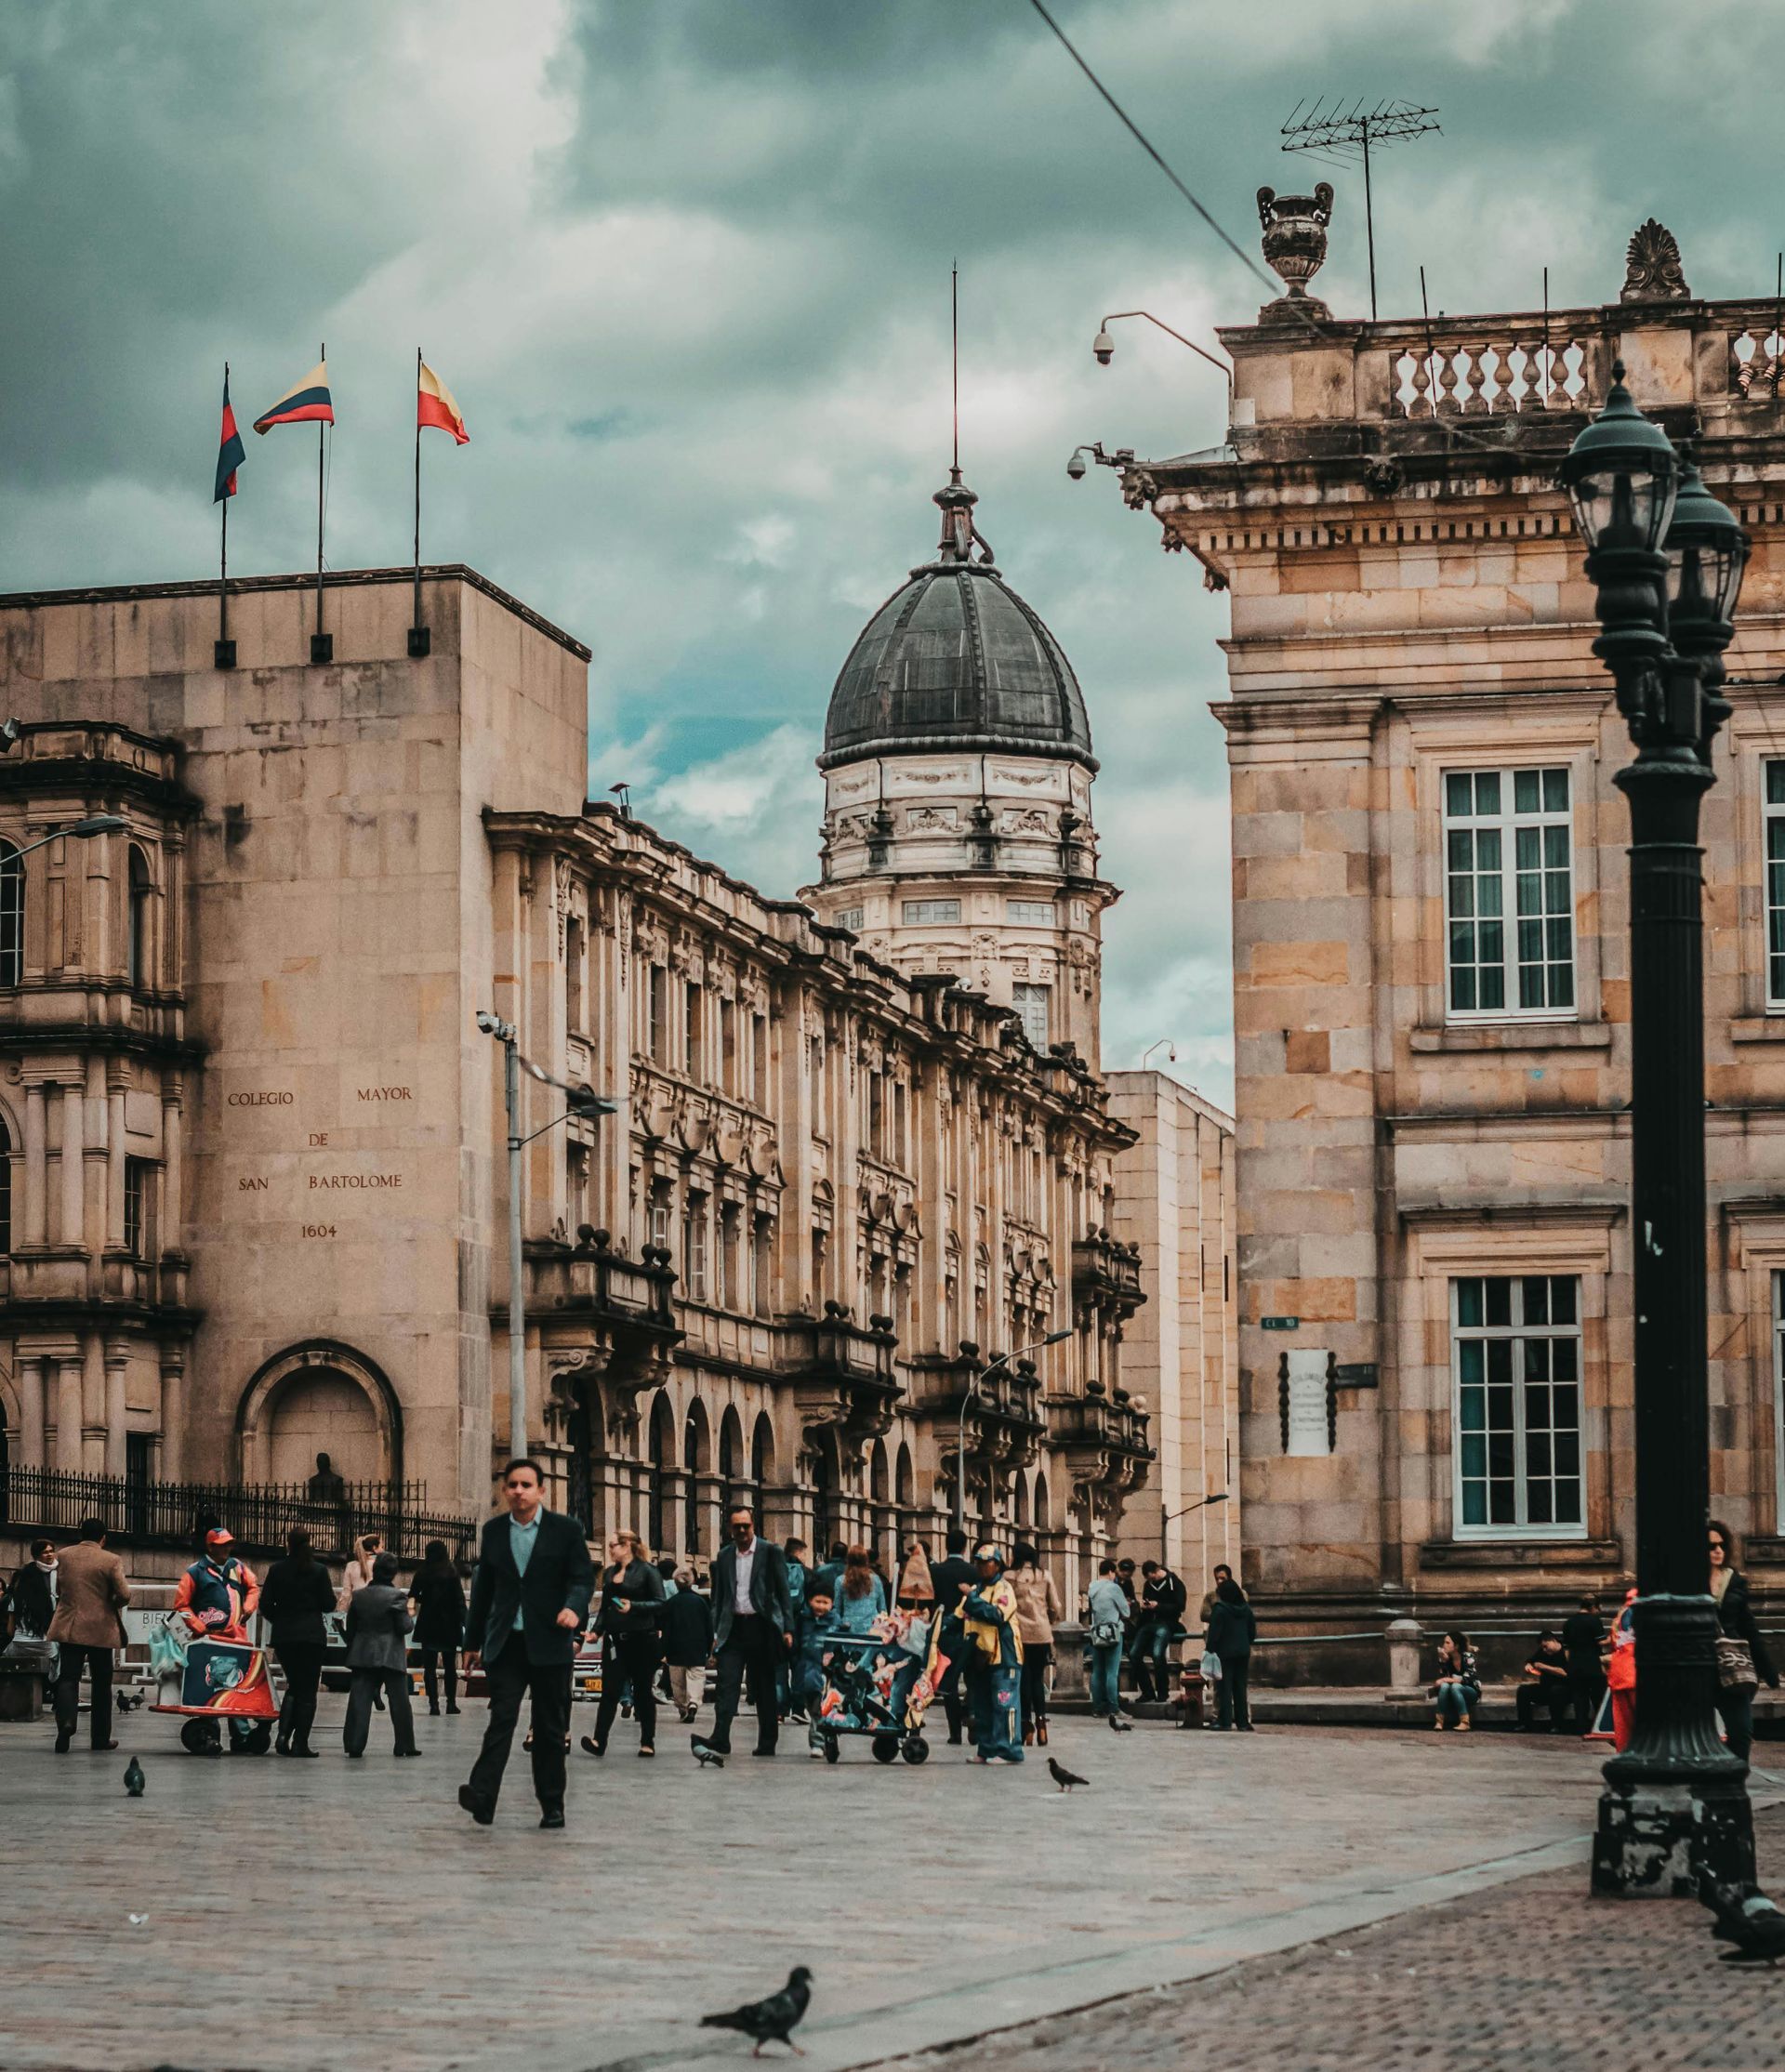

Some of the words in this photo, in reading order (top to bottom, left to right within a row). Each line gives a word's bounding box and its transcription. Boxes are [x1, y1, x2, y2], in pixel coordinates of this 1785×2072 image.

[228, 1091, 294, 1106] COLEGIO
[357, 1087, 412, 1102] MAYOR
[309, 1133, 328, 1146] DE
[238, 1178, 269, 1191] SAN
[309, 1174, 403, 1189] BARTOLOME
[301, 1225, 337, 1238] 1604
